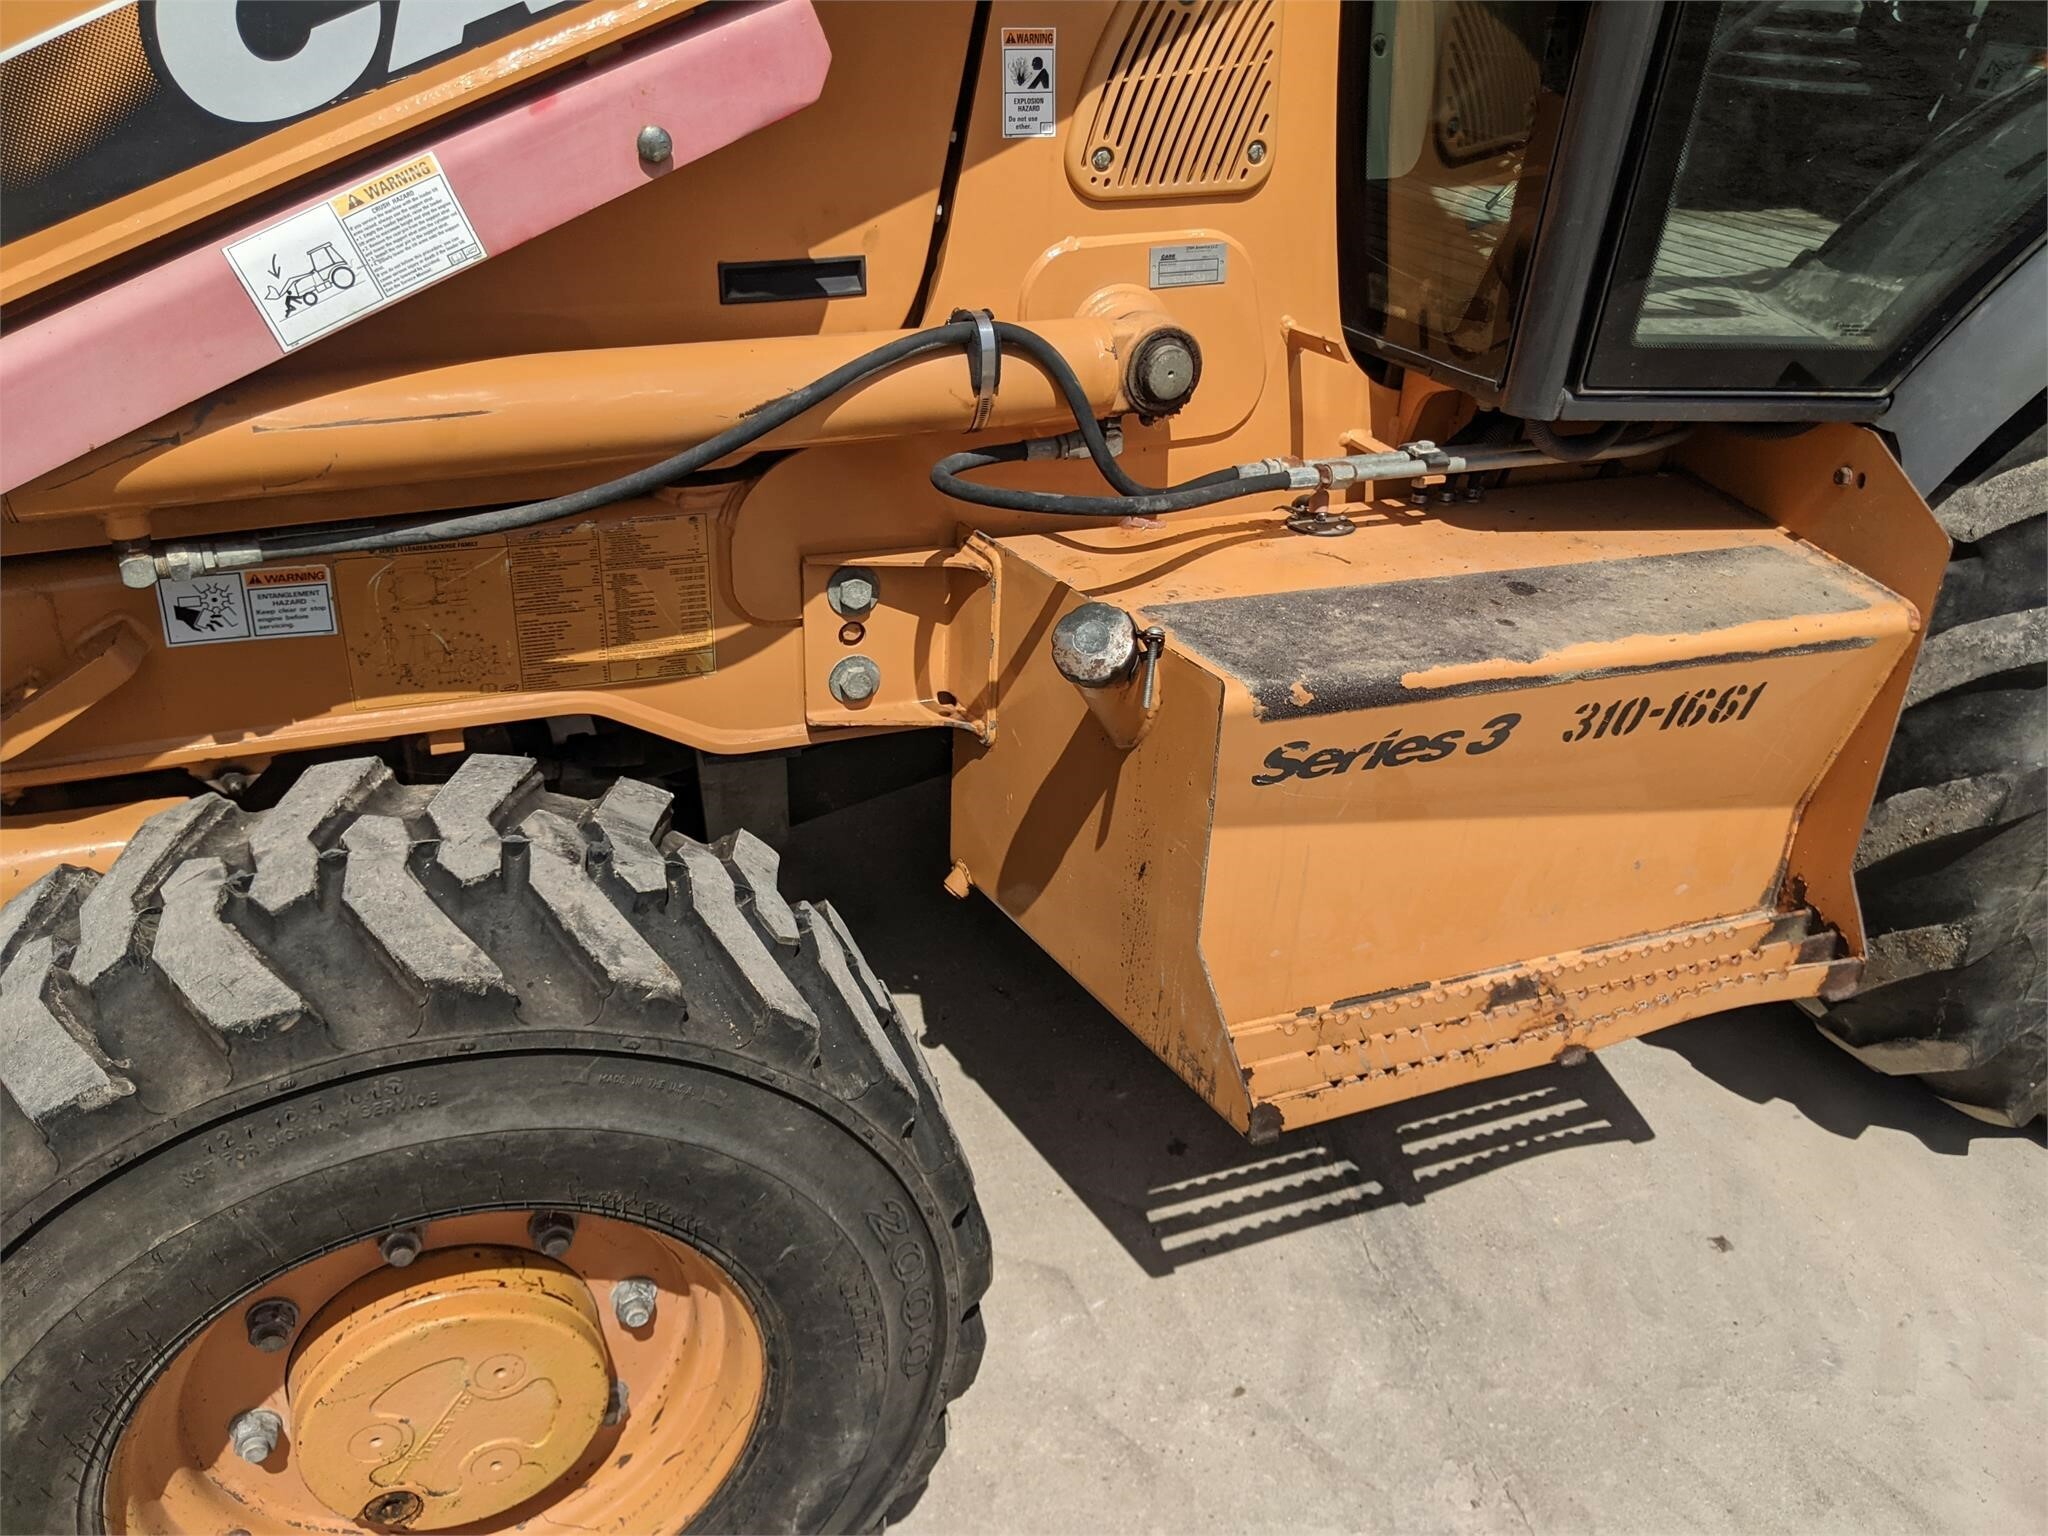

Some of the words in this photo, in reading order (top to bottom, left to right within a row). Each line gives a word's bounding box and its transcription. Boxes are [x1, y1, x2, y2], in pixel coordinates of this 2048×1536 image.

[1016, 33, 1054, 44] WARNING
[1013, 97, 1044, 105] EXPLOSION
[363, 162, 431, 201] WARNING
[371, 200, 391, 214] CRUSH
[391, 190, 415, 205] HAZARD
[264, 570, 325, 583] WARNING
[257, 590, 320, 600] ENTANGLEMENT
[272, 598, 307, 606] HAZARD
[256, 608, 276, 616] Keep
[310, 605, 327, 613] stop
[257, 616, 283, 624] engine
[285, 613, 309, 621] before
[259, 622, 294, 631] servicing.
[1562, 681, 1768, 743] 310-1661
[1251, 728, 1465, 786] Series
[1465, 712, 1522, 755] 3
[599, 1073, 626, 1086] MADE
[632, 1075, 644, 1087] IN
[648, 1078, 666, 1090] THE
[220, 1138, 262, 1163] FOR
[360, 1091, 440, 1119] SERVICE
[862, 1198, 934, 1381] 2000
